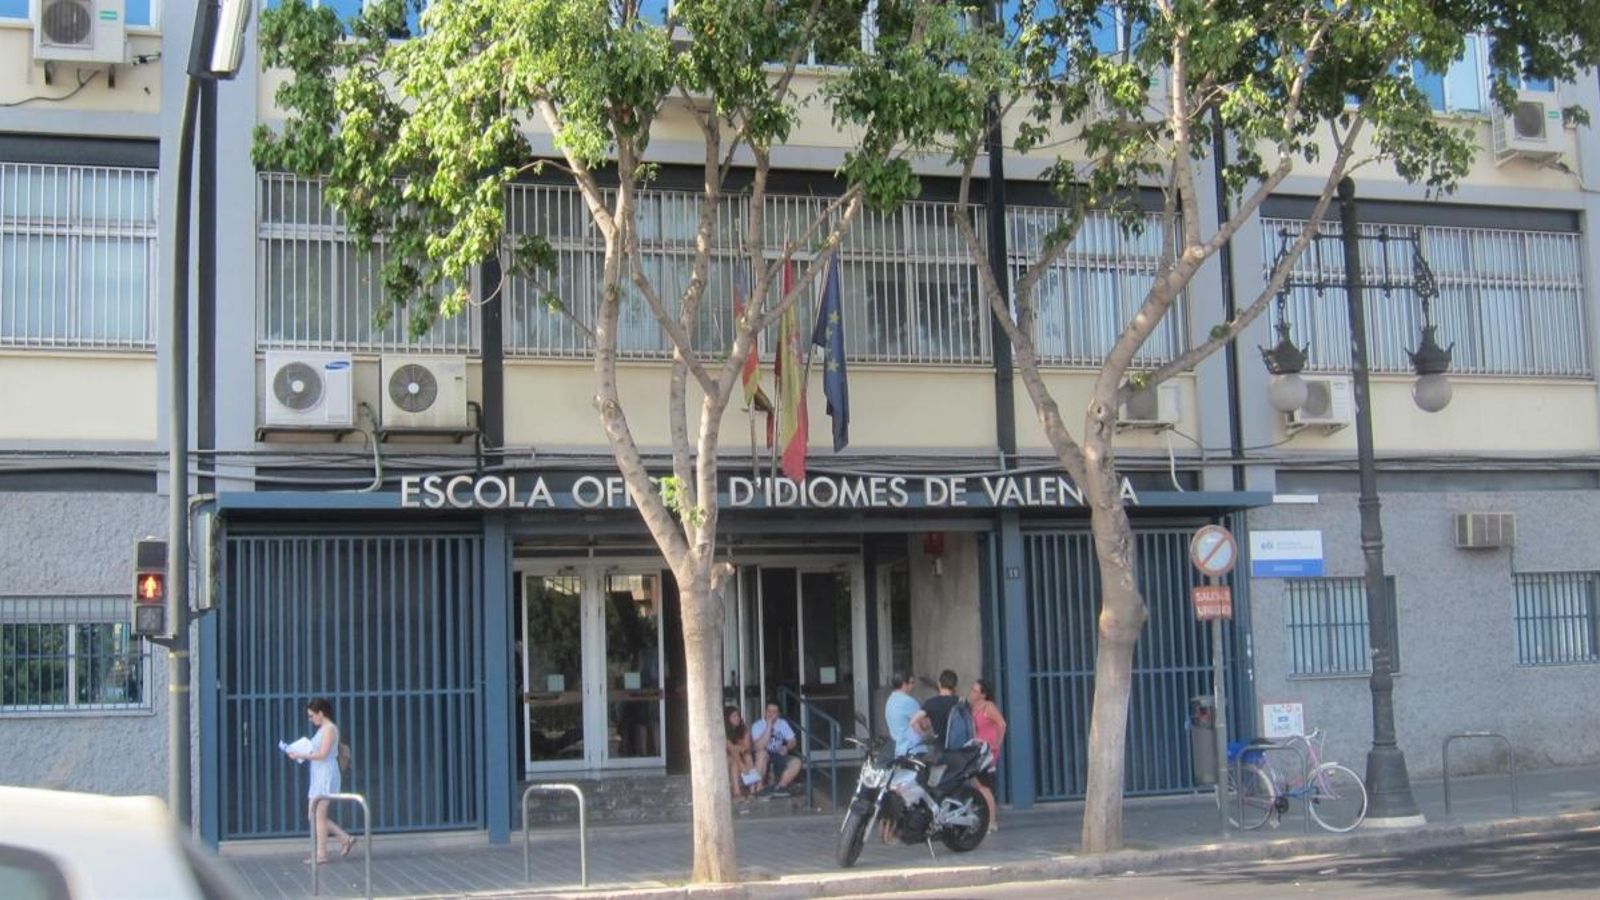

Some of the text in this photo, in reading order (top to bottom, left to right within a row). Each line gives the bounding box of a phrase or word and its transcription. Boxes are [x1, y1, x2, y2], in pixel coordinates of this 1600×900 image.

[401, 475, 556, 509] ESCOLA
[729, 476, 908, 508] D'IDIOMES
[924, 477, 967, 507] DE
[982, 475, 1139, 507] VALENA
